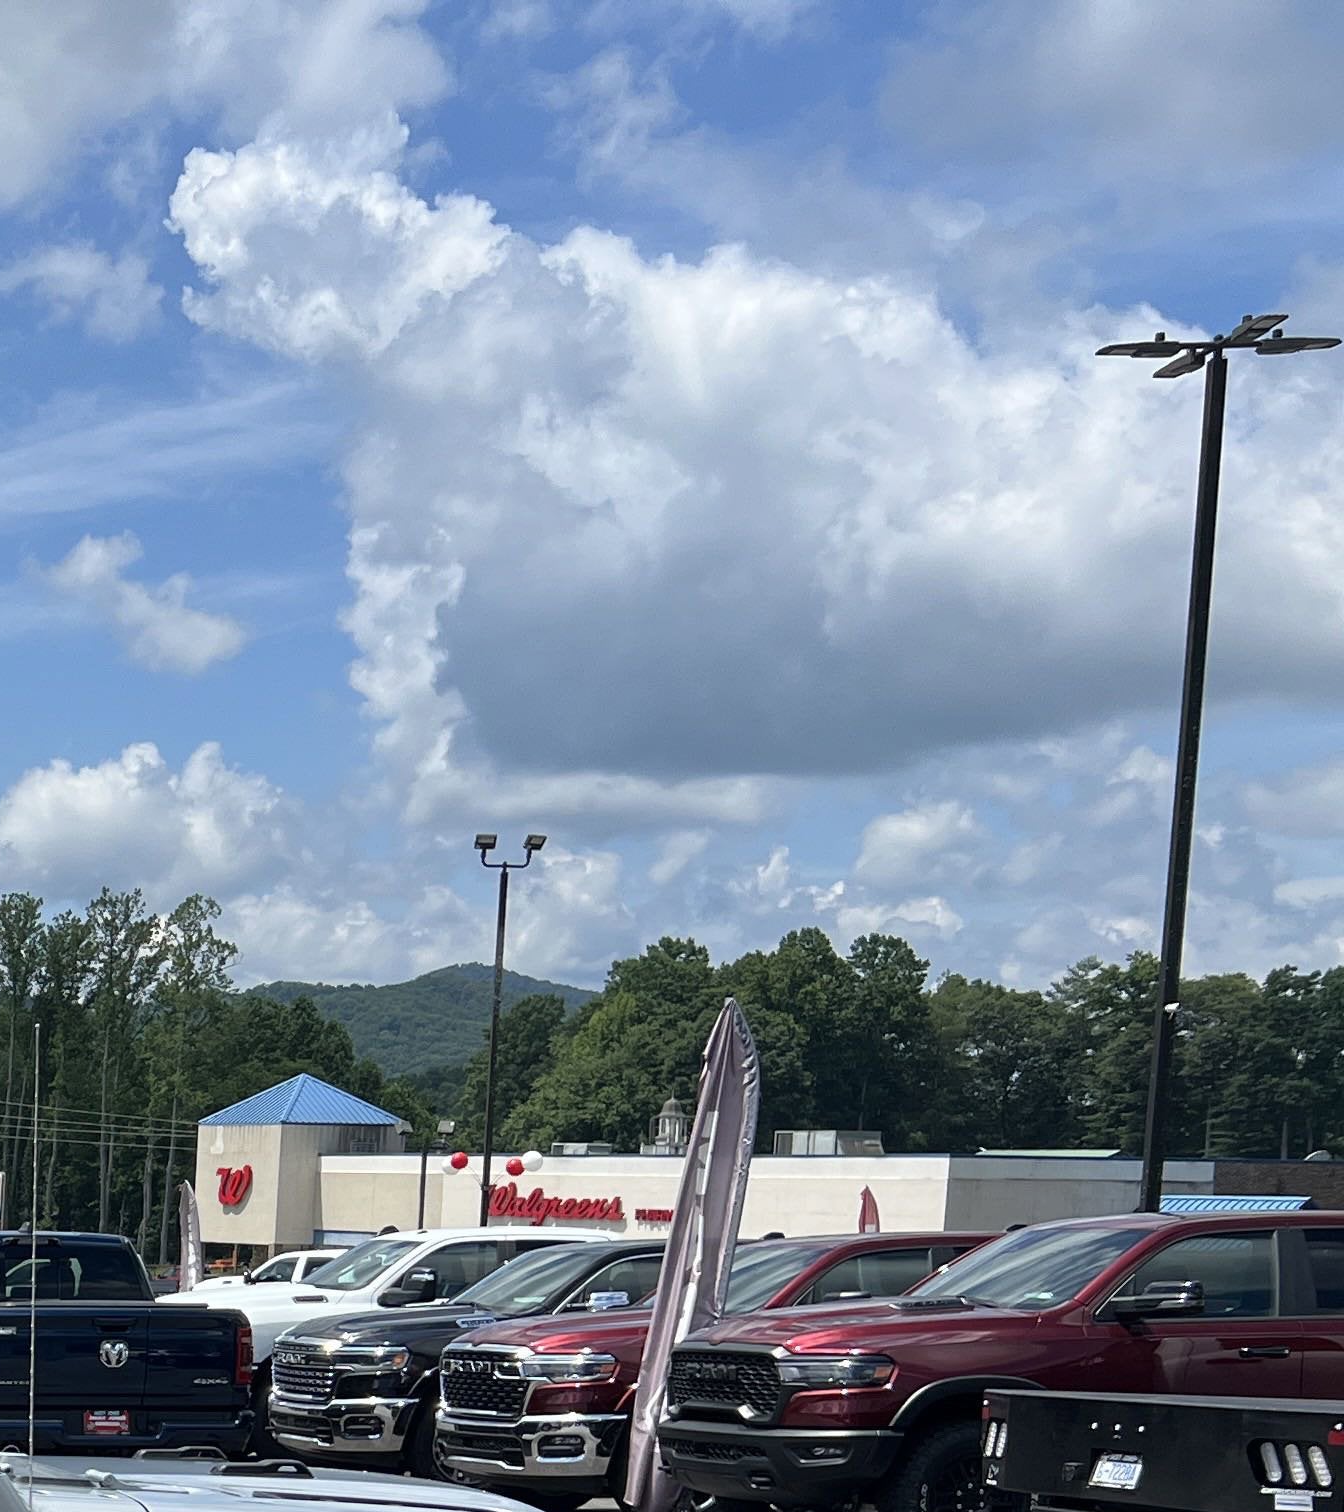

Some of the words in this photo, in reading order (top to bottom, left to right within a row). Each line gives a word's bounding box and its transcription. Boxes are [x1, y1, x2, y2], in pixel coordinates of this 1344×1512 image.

[488, 1182, 625, 1227] Walgreens
[634, 1209, 674, 1222] PHARM
[448, 1359, 492, 1373] RAM
